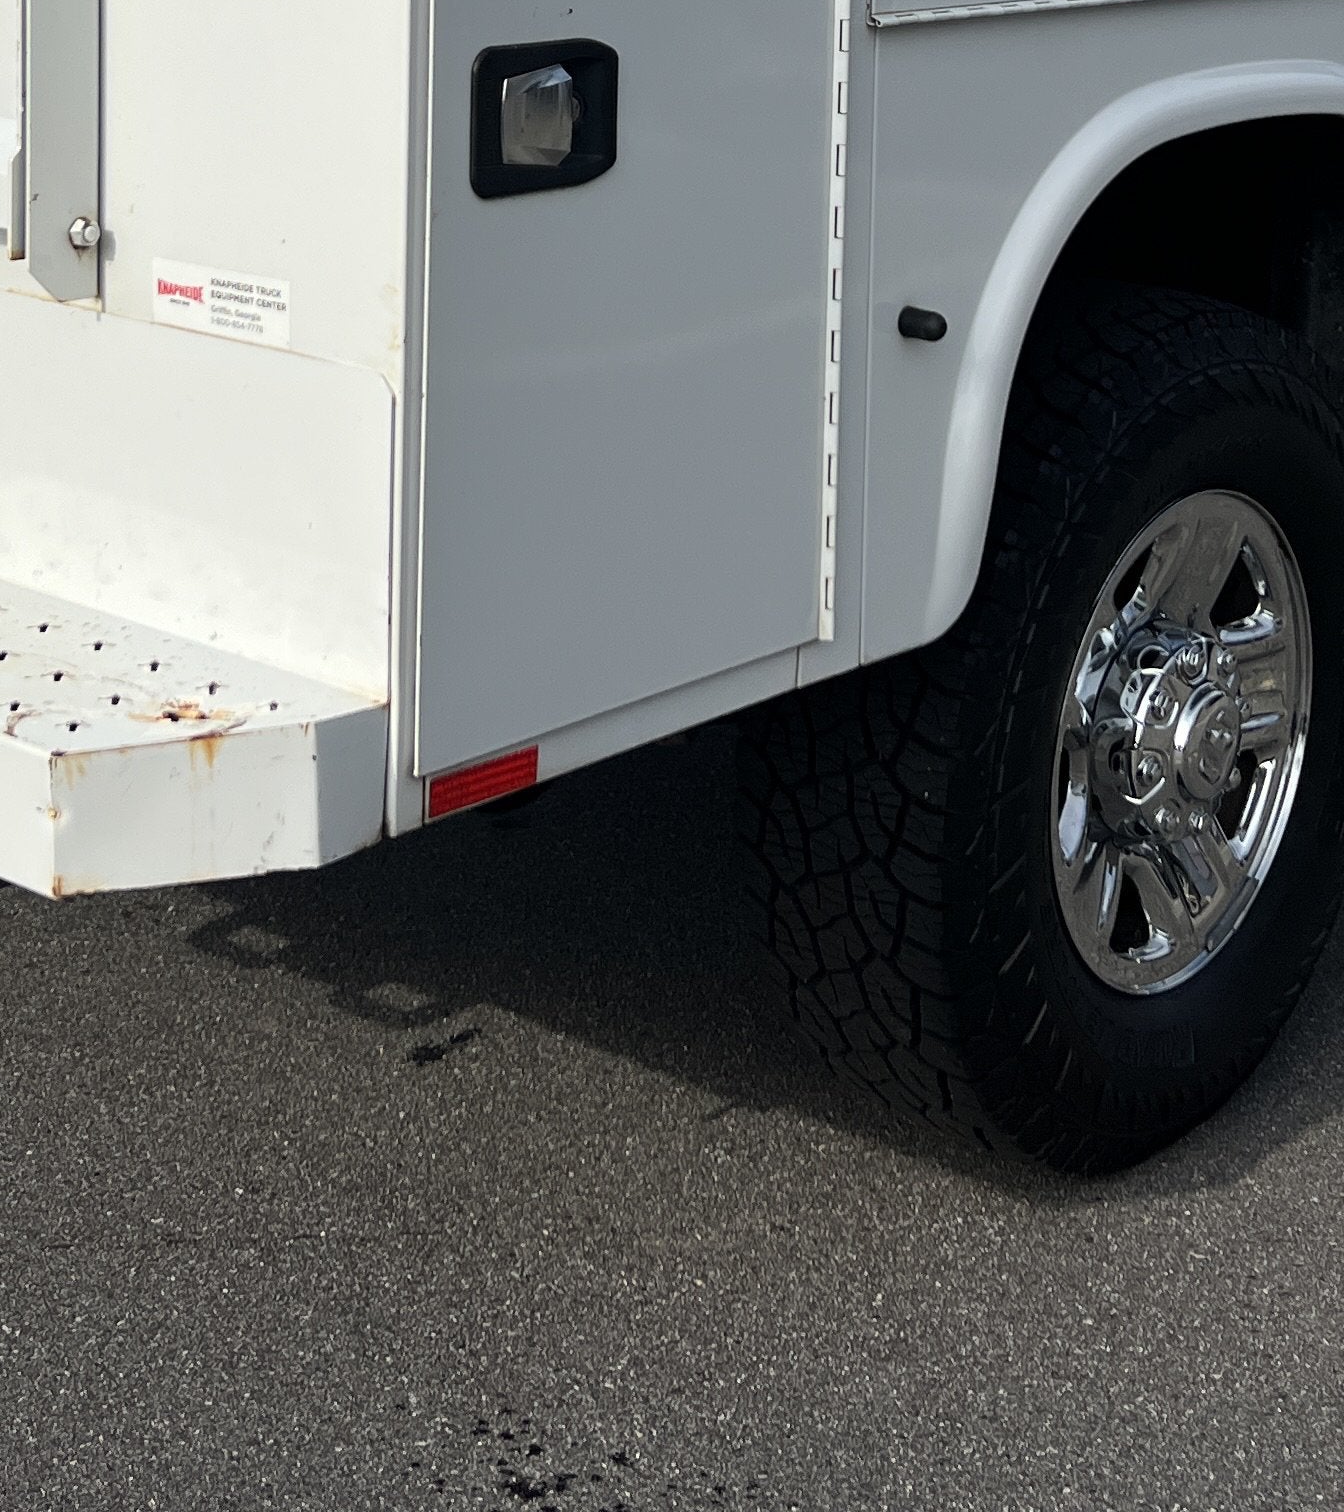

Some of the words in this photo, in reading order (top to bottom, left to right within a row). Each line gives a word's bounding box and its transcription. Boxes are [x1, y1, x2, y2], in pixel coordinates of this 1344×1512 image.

[157, 277, 205, 304] KNAPHEIDE
[210, 277, 254, 293] KNAPHEIDE
[255, 285, 282, 299] TRUCK
[210, 290, 255, 306] EQUIPMENT
[256, 298, 287, 312] CENTER
